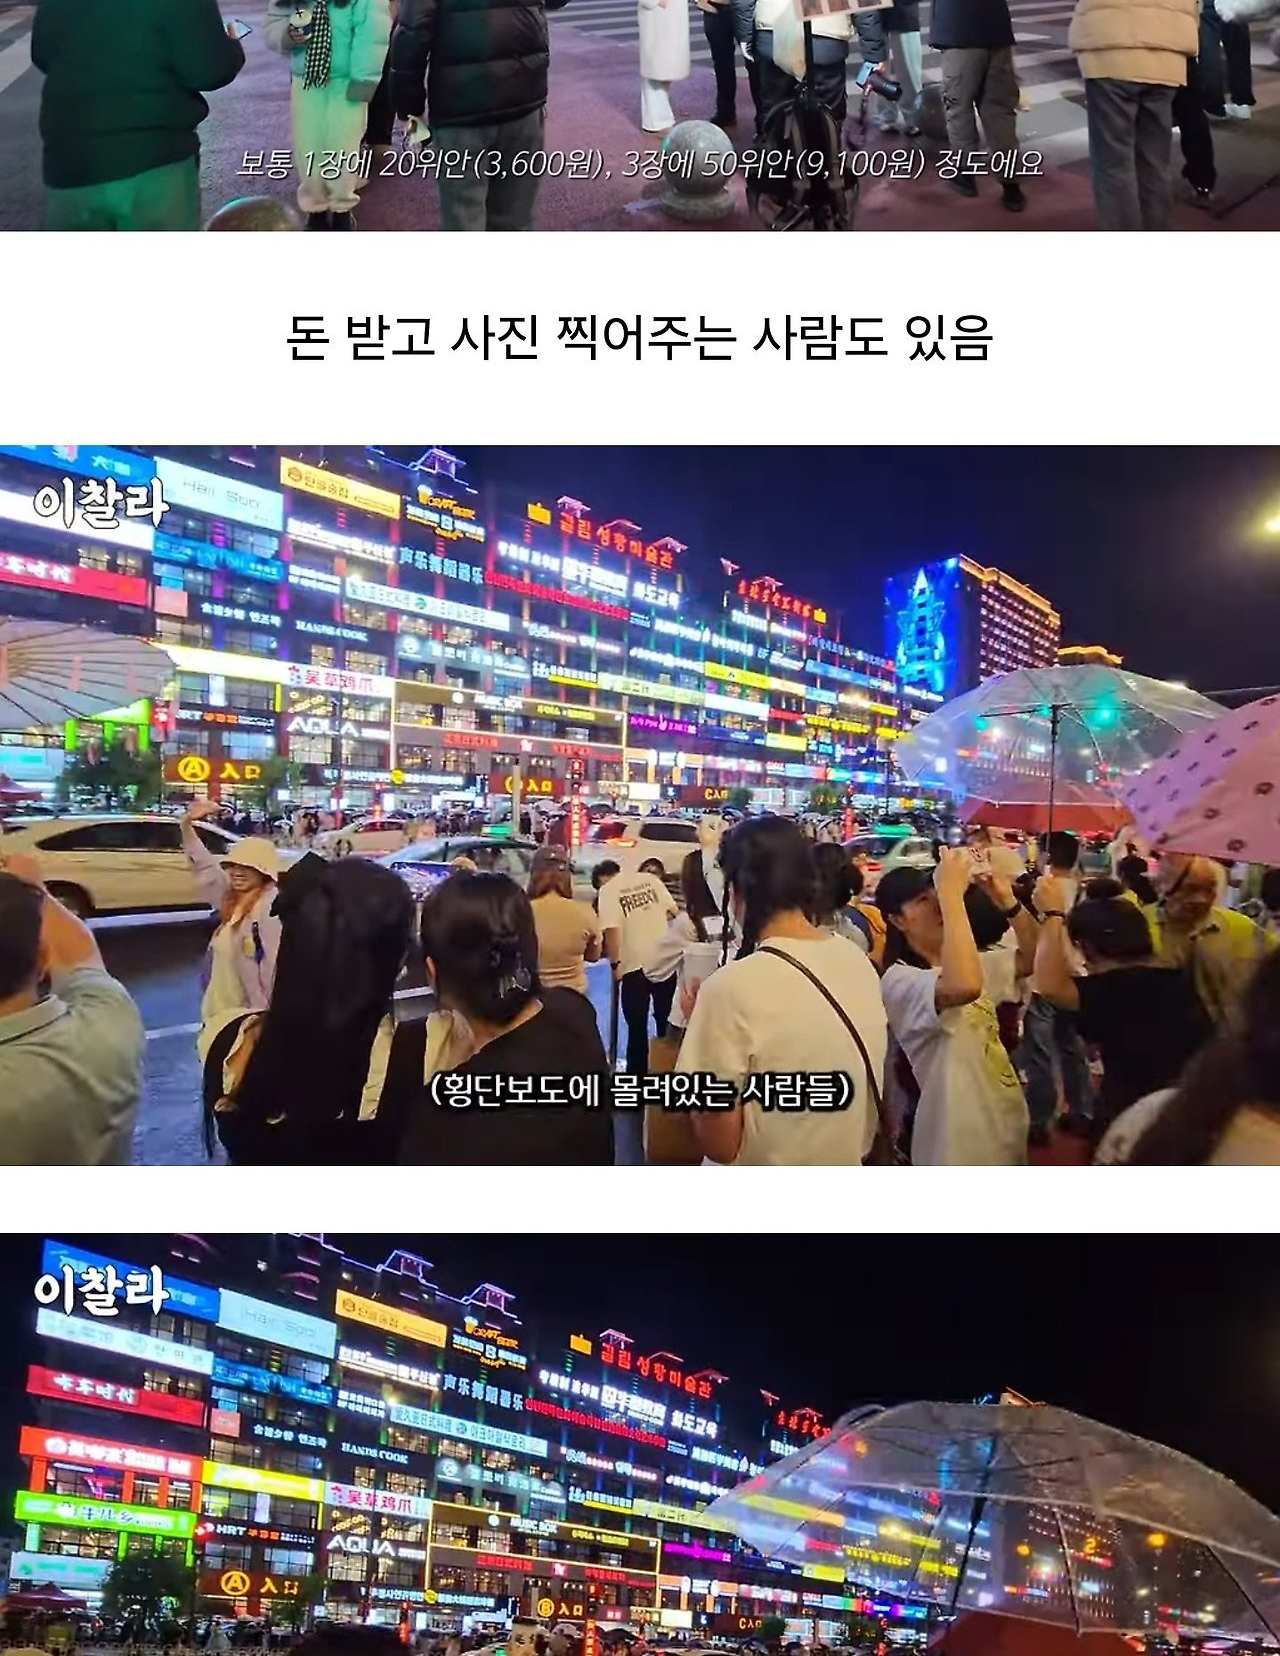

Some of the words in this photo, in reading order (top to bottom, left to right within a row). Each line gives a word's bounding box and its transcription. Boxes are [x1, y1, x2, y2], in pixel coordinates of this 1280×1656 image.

[219, 762, 262, 780] 入口
[347, 1488, 413, 1515] 吴草鸡爪
[215, 1524, 247, 1537] HRT
[325, 1534, 397, 1557] AQUA
[259, 1577, 300, 1595] 入口
[558, 1602, 584, 1616] 入口
